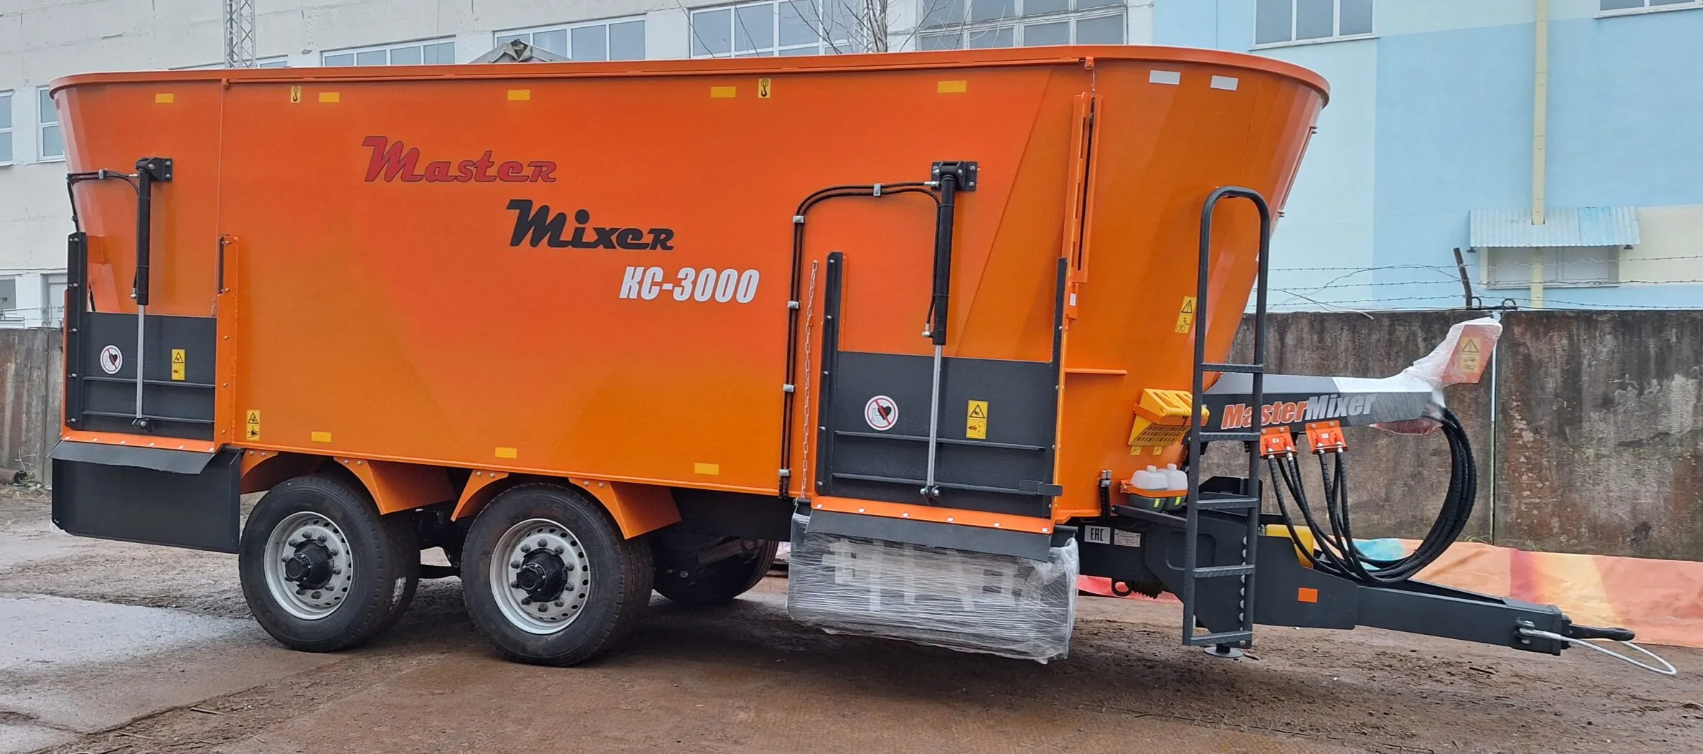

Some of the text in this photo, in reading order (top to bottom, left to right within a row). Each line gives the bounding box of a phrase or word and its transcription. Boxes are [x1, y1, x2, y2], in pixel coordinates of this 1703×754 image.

[362, 136, 556, 182] Master
[506, 199, 674, 250] Mixer
[1090, 527, 1104, 541] EAC
